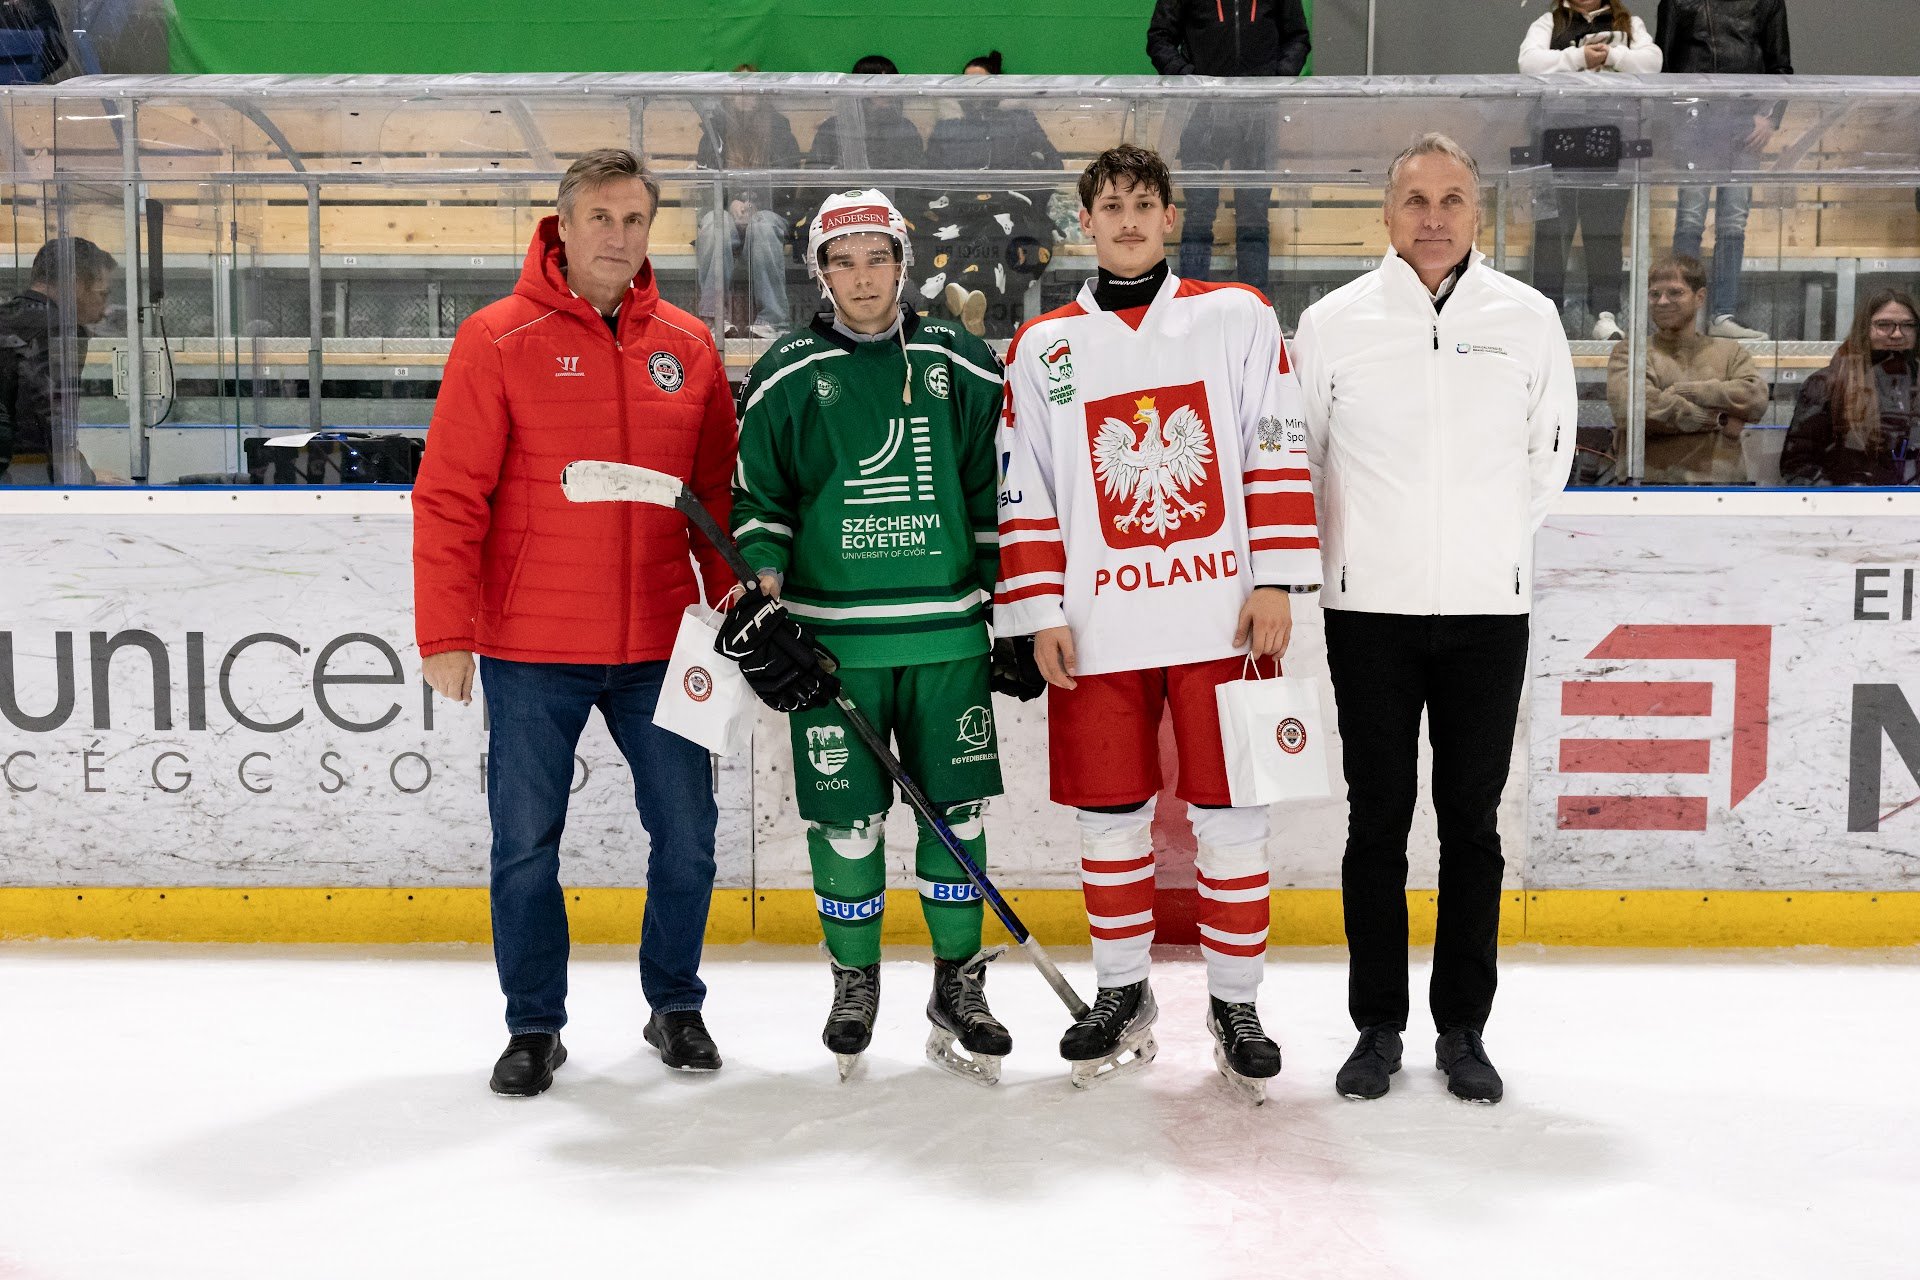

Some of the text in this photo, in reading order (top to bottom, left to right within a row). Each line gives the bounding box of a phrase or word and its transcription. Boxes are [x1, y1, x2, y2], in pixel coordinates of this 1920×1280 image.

[826, 213, 884, 230] ANDERSEN
[1057, 396, 1073, 405] TEAM
[1286, 431, 1306, 444] Spo
[841, 514, 941, 533] SZÉCHENYI
[841, 531, 926, 549] EGYETEM
[841, 550, 889, 560] UNIVERSITY
[890, 550, 902, 558] OF
[1094, 550, 1238, 596] POLAND
[0, 629, 490, 734] unice
[815, 778, 850, 791] GYŐR
[822, 892, 885, 919] BÜCH
